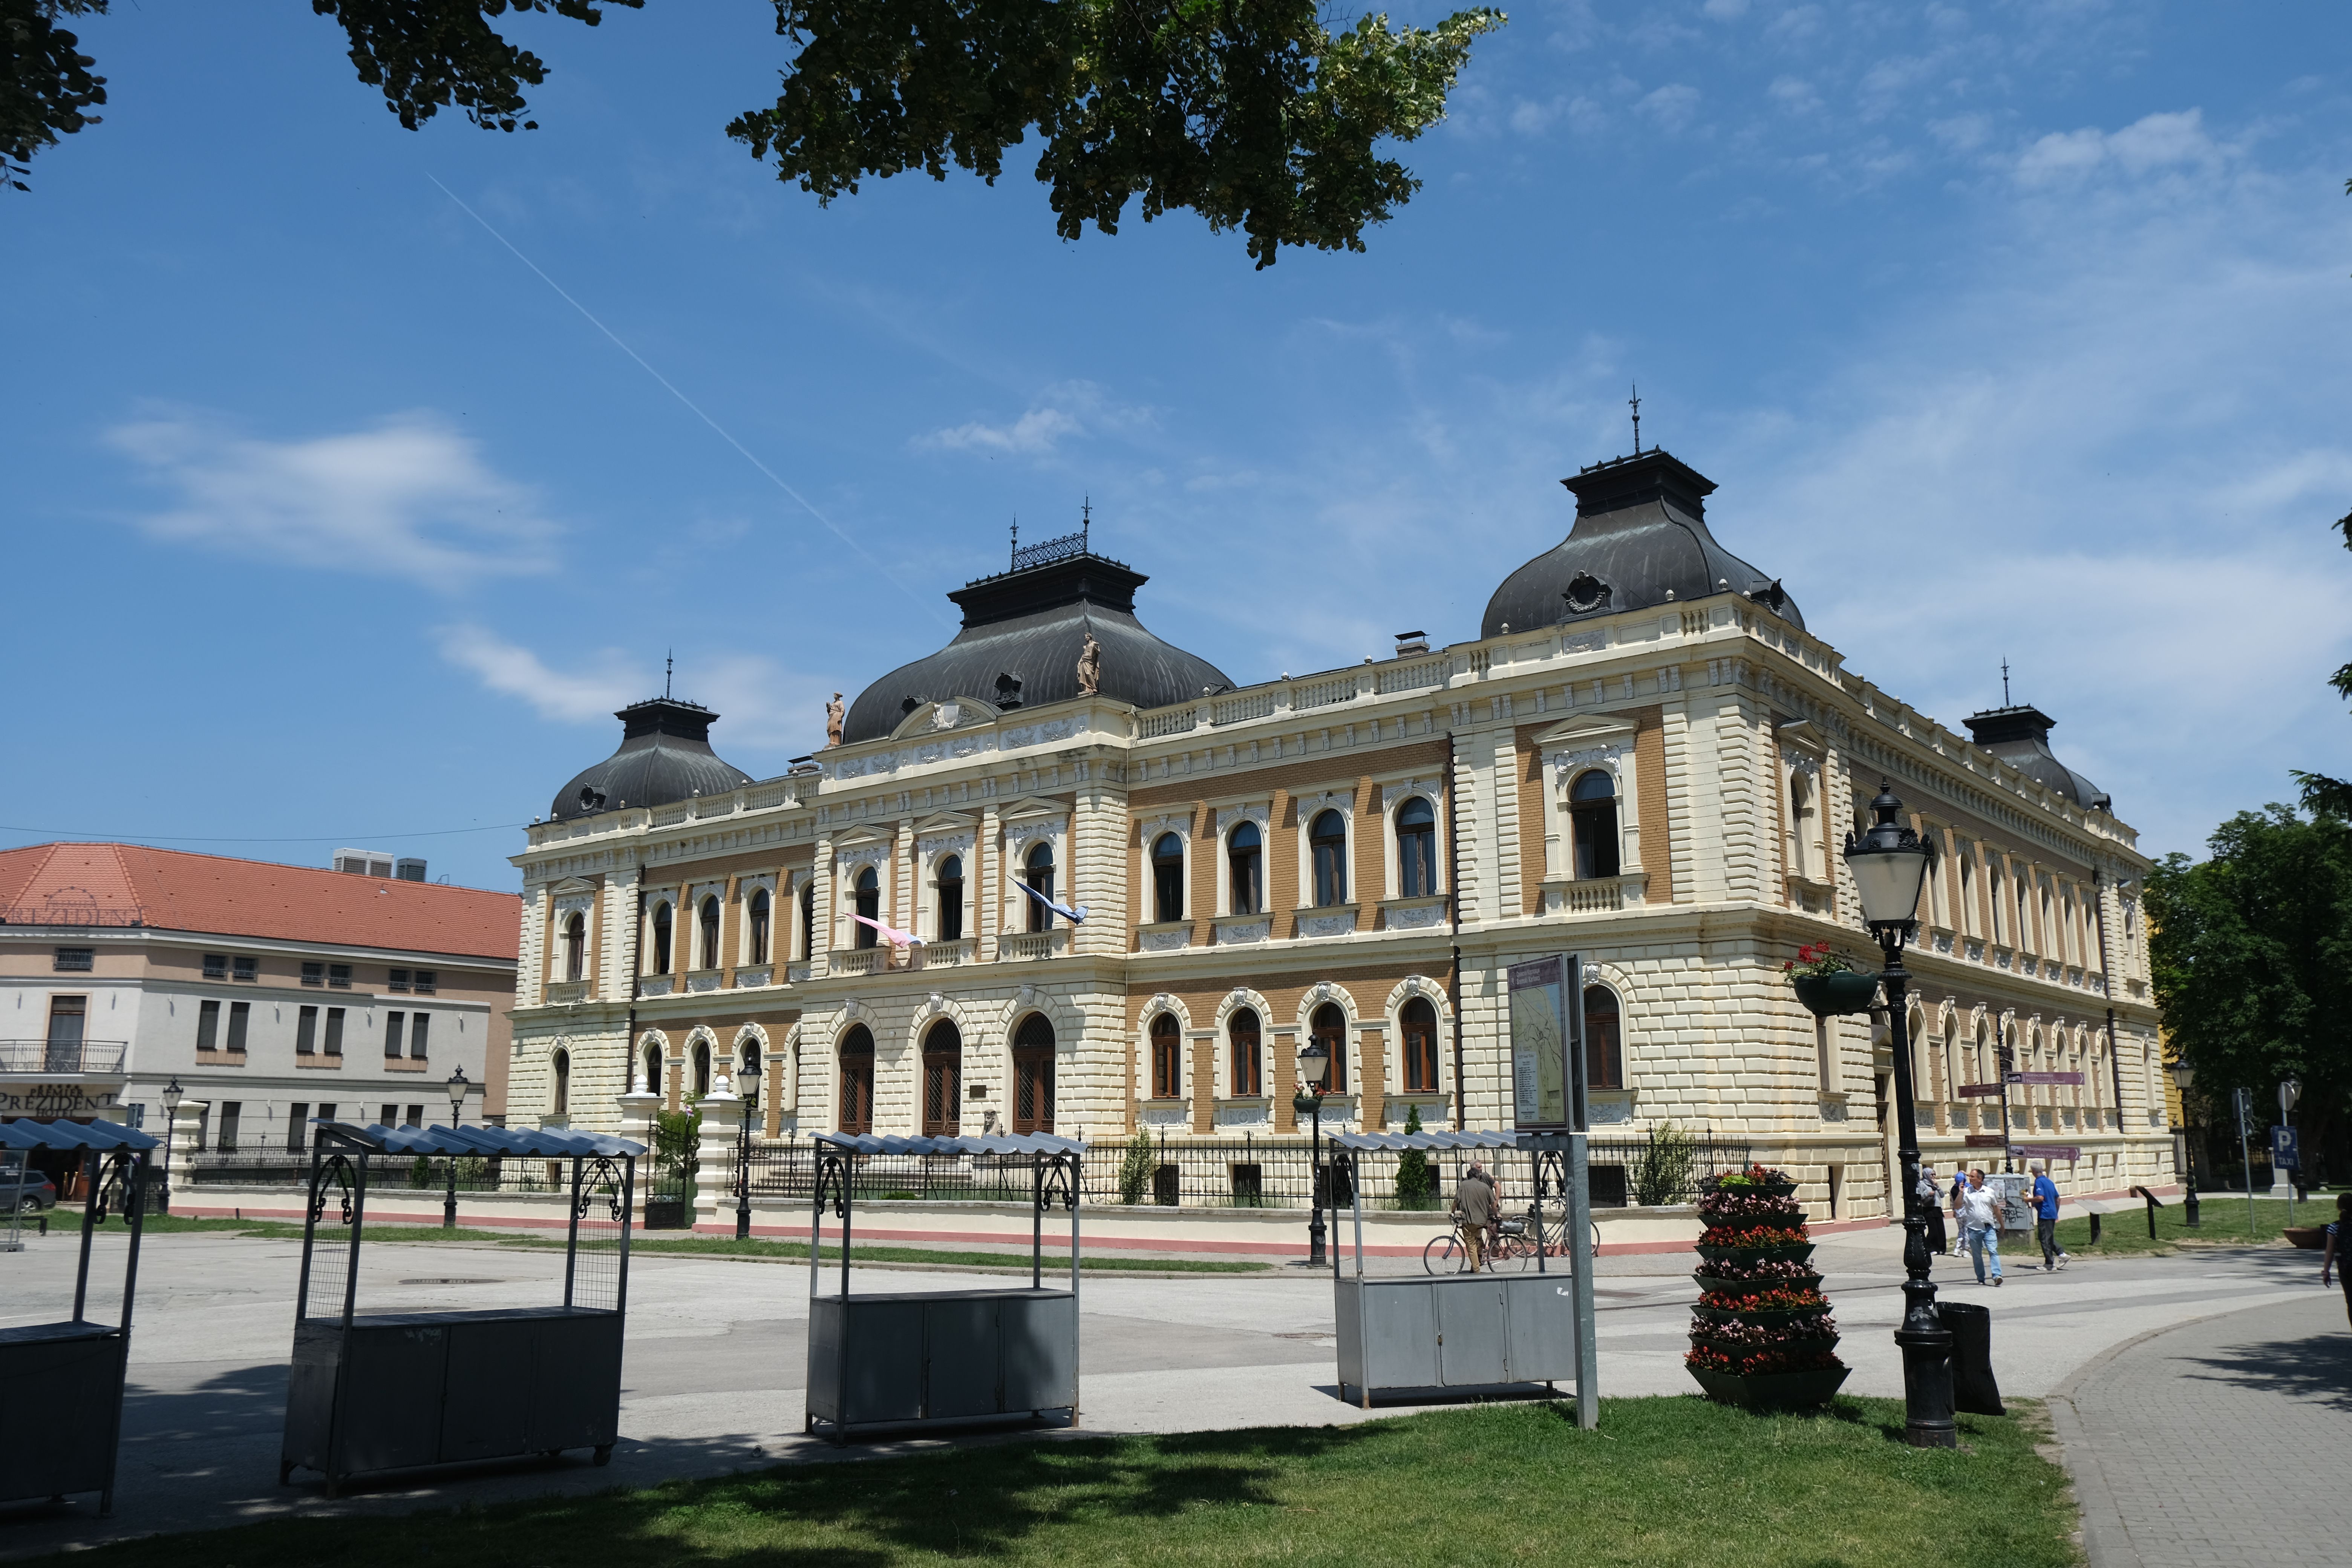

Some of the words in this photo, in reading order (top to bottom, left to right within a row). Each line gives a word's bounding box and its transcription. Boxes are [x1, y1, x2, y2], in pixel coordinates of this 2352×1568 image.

[30, 1089, 83, 1097] PREMIER
[0, 1093, 118, 1110] PREZIDENT
[2278, 1130, 2292, 1152] P
[2278, 1157, 2294, 1165] TAXI
